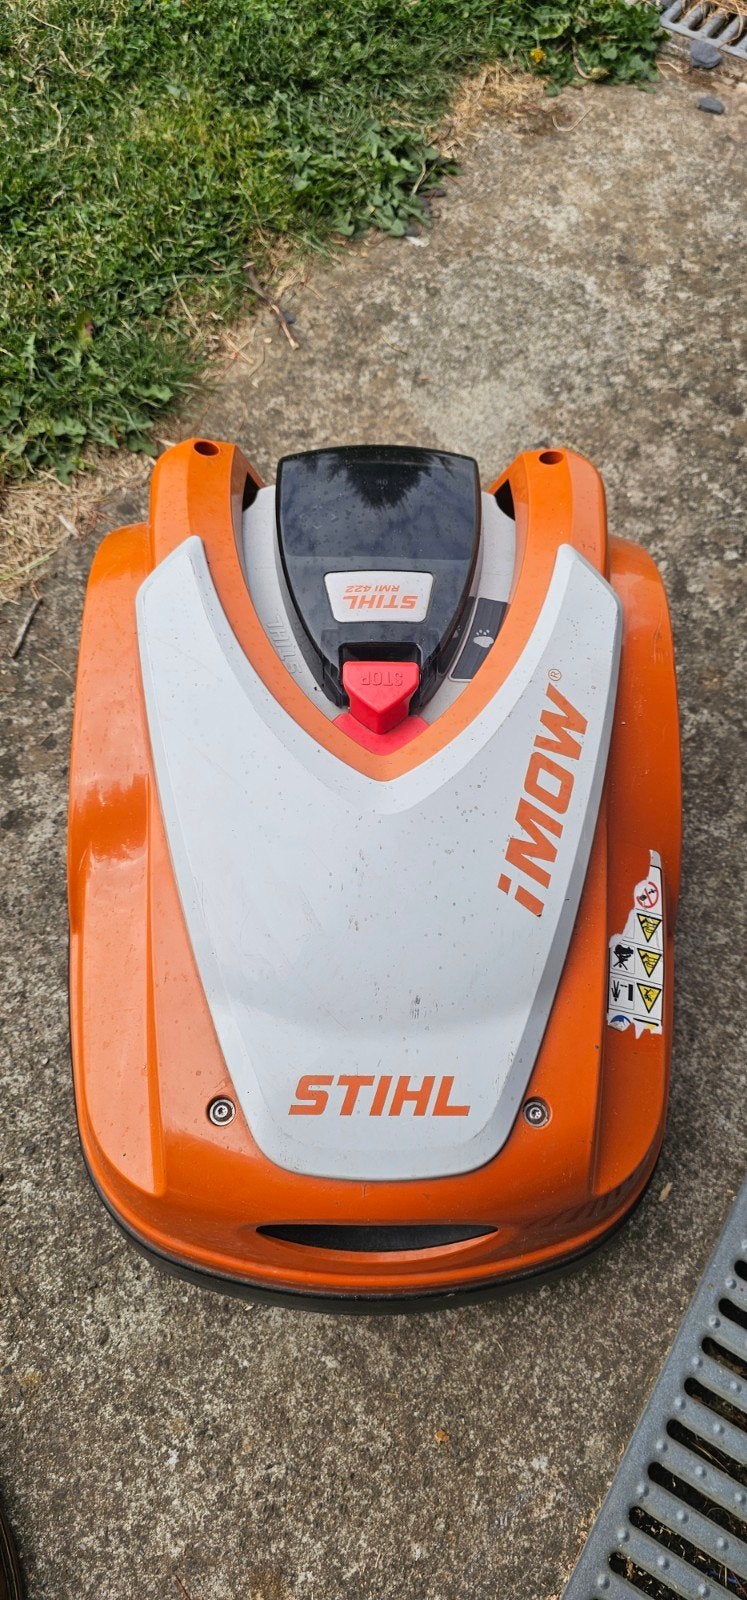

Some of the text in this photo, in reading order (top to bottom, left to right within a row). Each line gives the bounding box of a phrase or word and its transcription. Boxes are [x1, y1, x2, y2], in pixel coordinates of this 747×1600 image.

[345, 585, 371, 593] 422
[343, 595, 418, 609] STIHL
[266, 613, 302, 674] STIHL
[361, 673, 403, 687] STOP
[288, 1075, 470, 1116] STIHL
